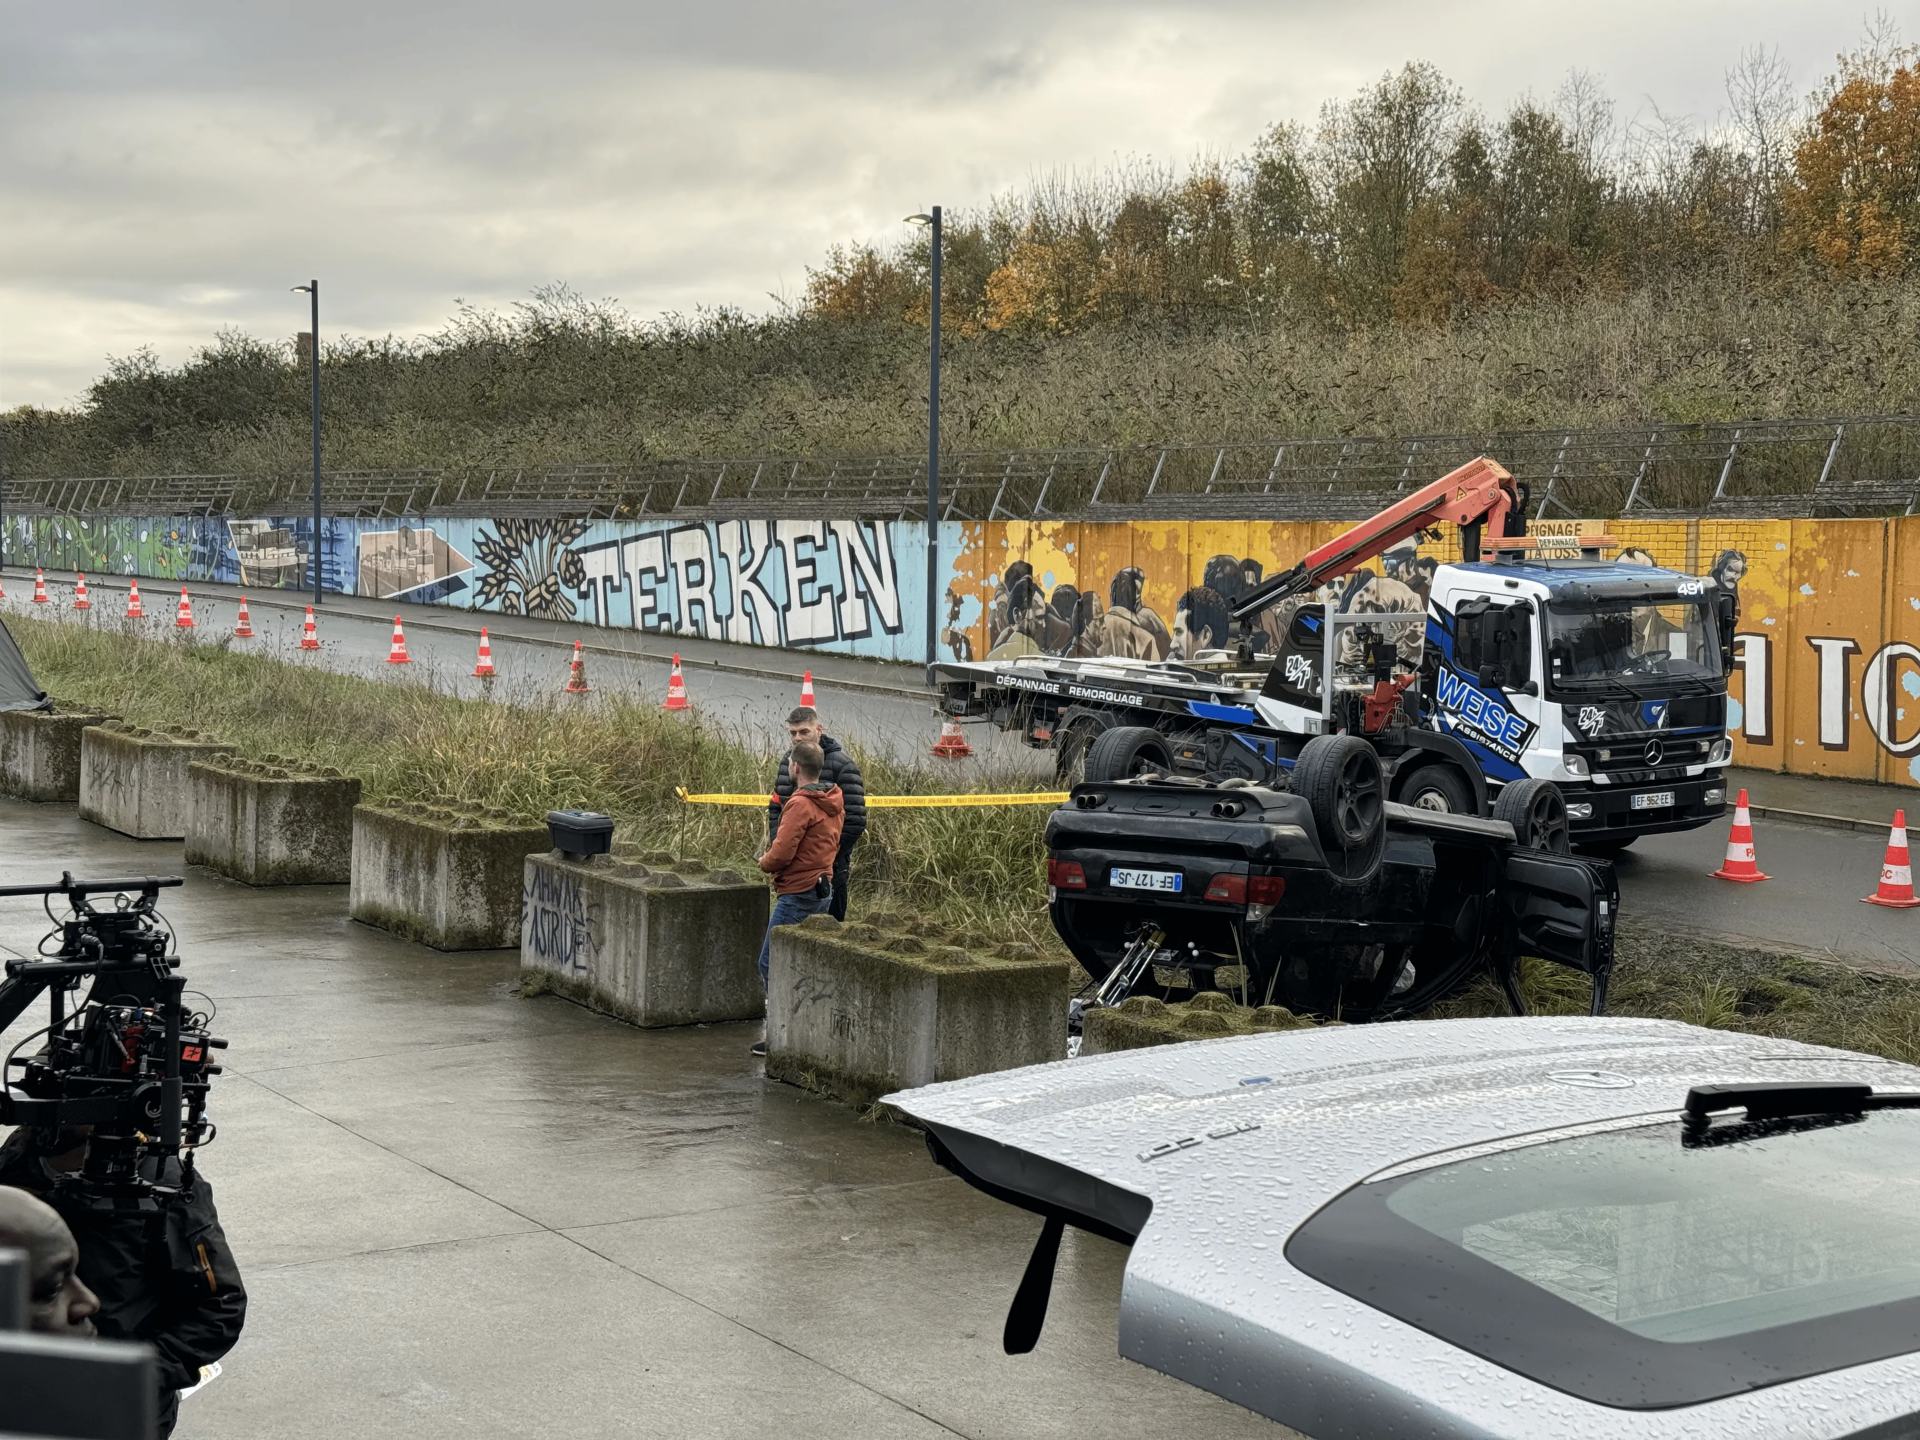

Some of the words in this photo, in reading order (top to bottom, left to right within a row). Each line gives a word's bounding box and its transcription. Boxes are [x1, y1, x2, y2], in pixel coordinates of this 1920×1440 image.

[578, 519, 904, 648] TERKEN
[1677, 580, 1704, 596] 491
[996, 674, 1061, 694] DÉPANNAGE
[1068, 686, 1144, 706] REMORQUAGE
[1436, 665, 1529, 753] WEISE
[1457, 723, 1518, 762] ASSISTANCE
